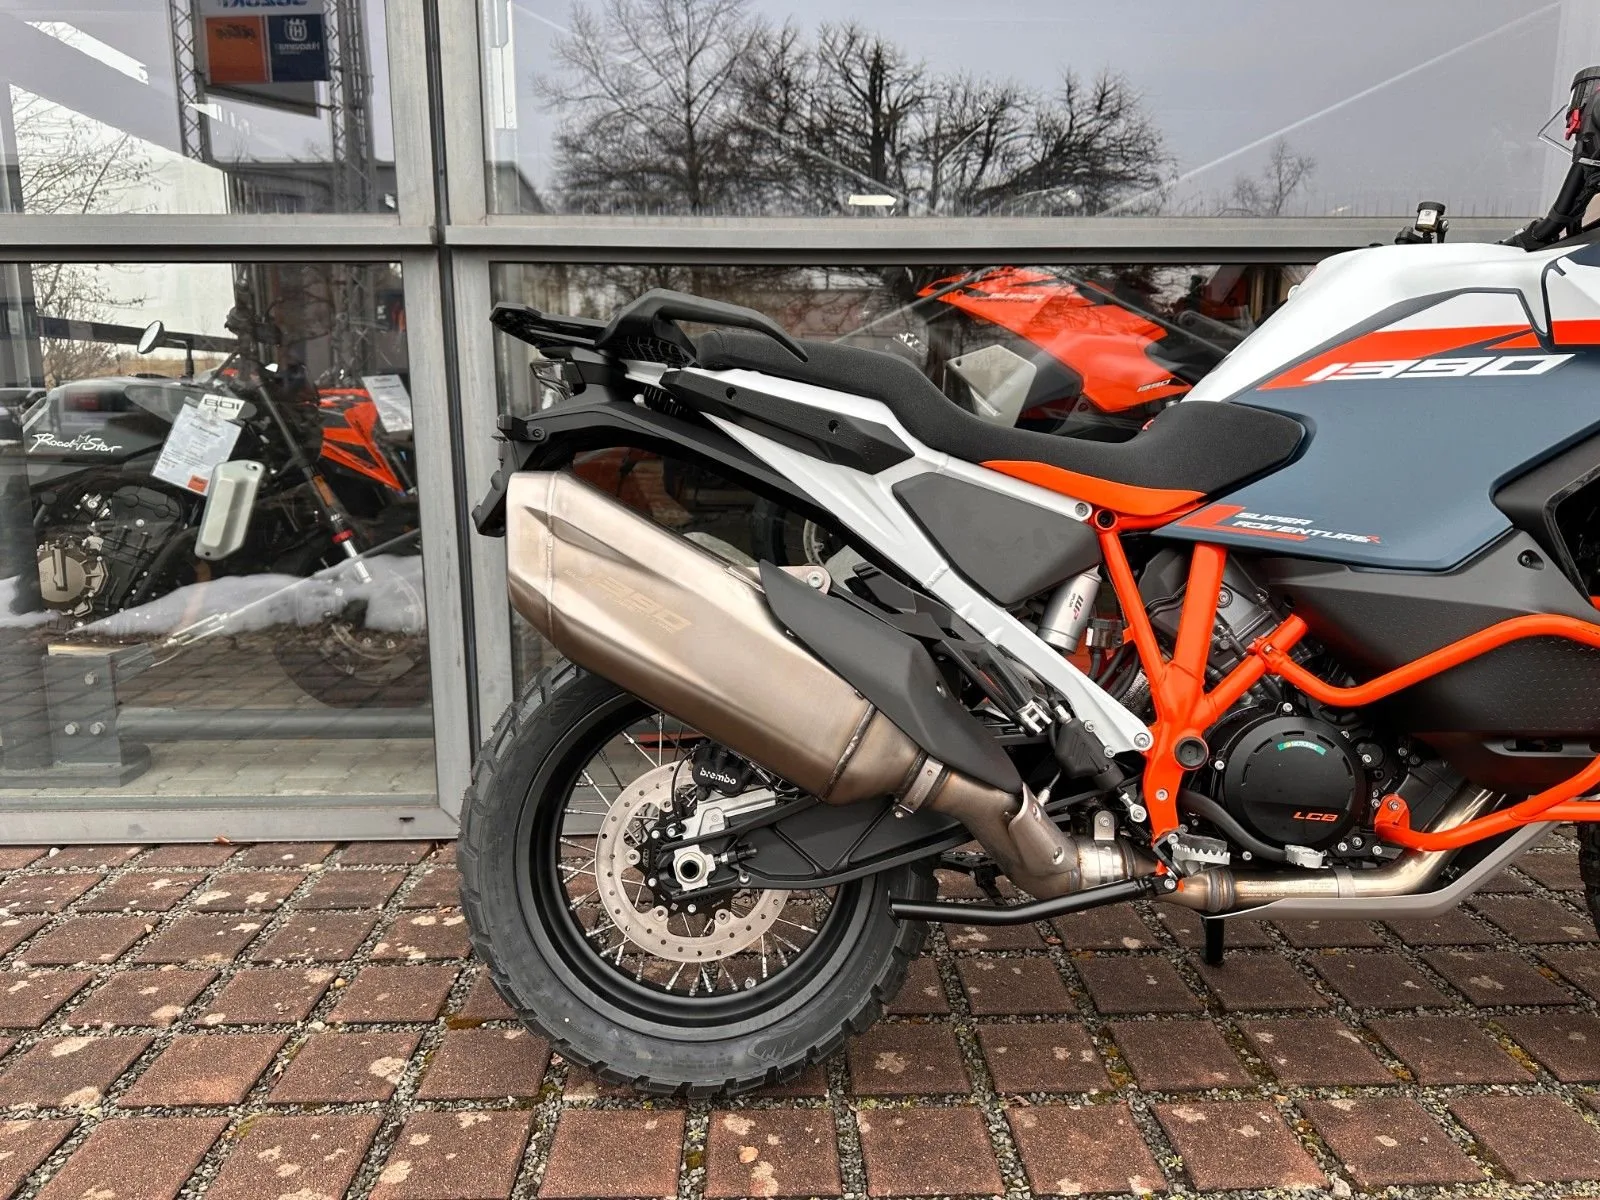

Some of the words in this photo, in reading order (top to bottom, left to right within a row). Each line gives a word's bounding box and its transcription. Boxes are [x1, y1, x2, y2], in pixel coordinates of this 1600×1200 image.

[1302, 353, 1576, 381] 1390
[1234, 512, 1314, 526] SUPER
[699, 767, 737, 785] brembo
